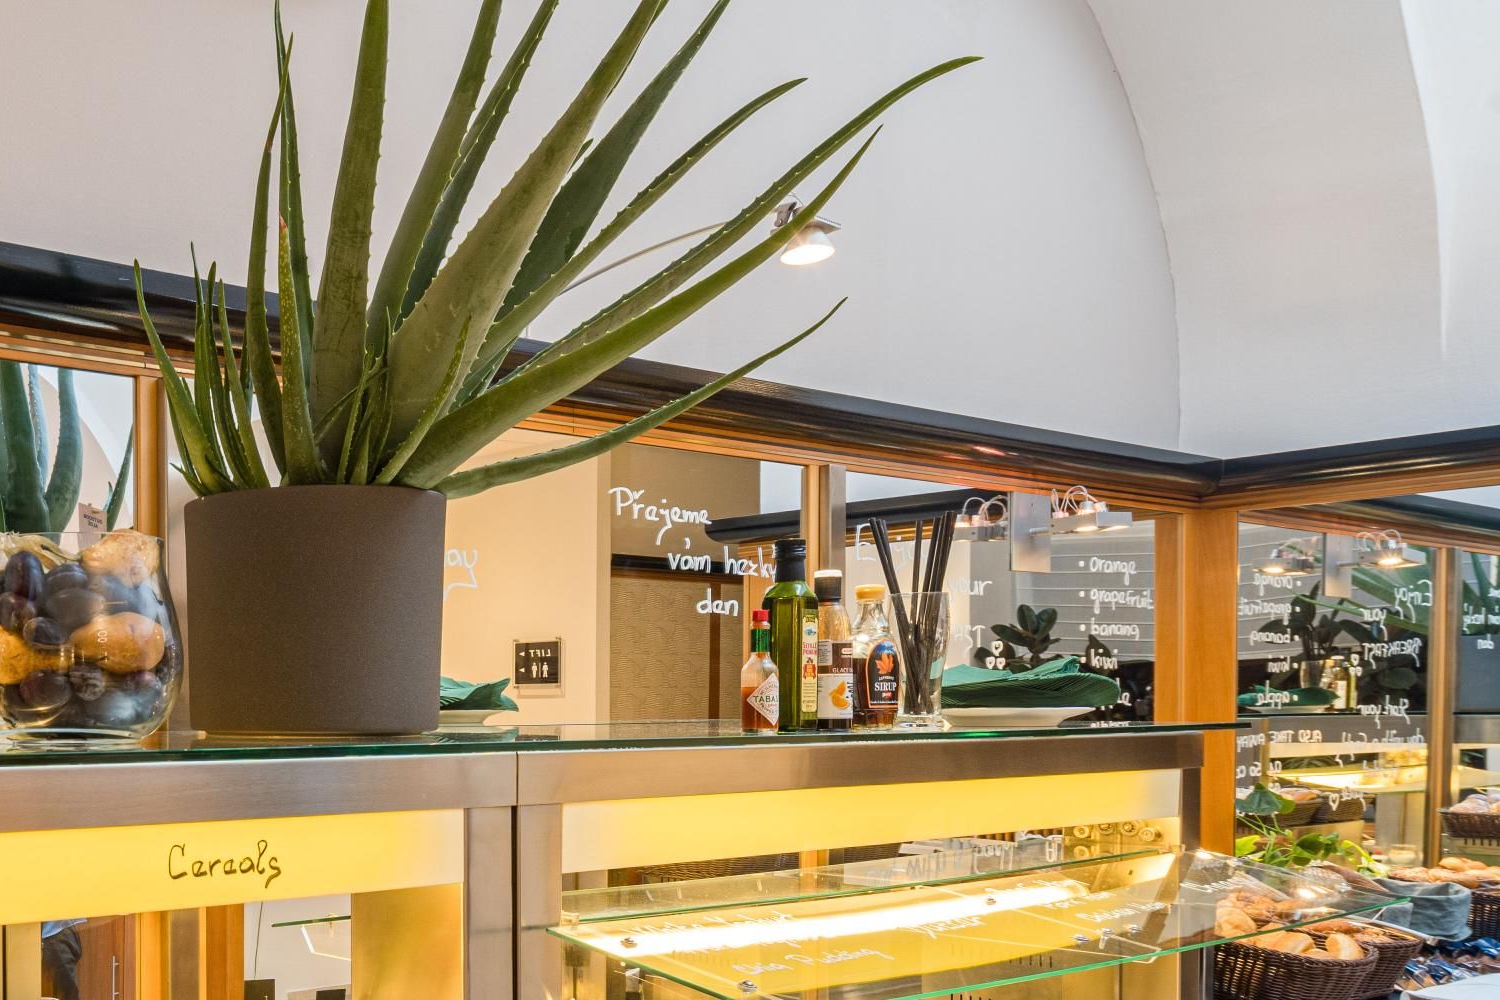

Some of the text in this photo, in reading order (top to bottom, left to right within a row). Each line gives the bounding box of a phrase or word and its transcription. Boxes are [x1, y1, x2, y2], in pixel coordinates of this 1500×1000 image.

[696, 587, 739, 616] den
[1090, 617, 1140, 641] banana
[1090, 649, 1118, 670] kiwi
[874, 682, 897, 692] SIRUP
[168, 838, 282, 889] Cereals
